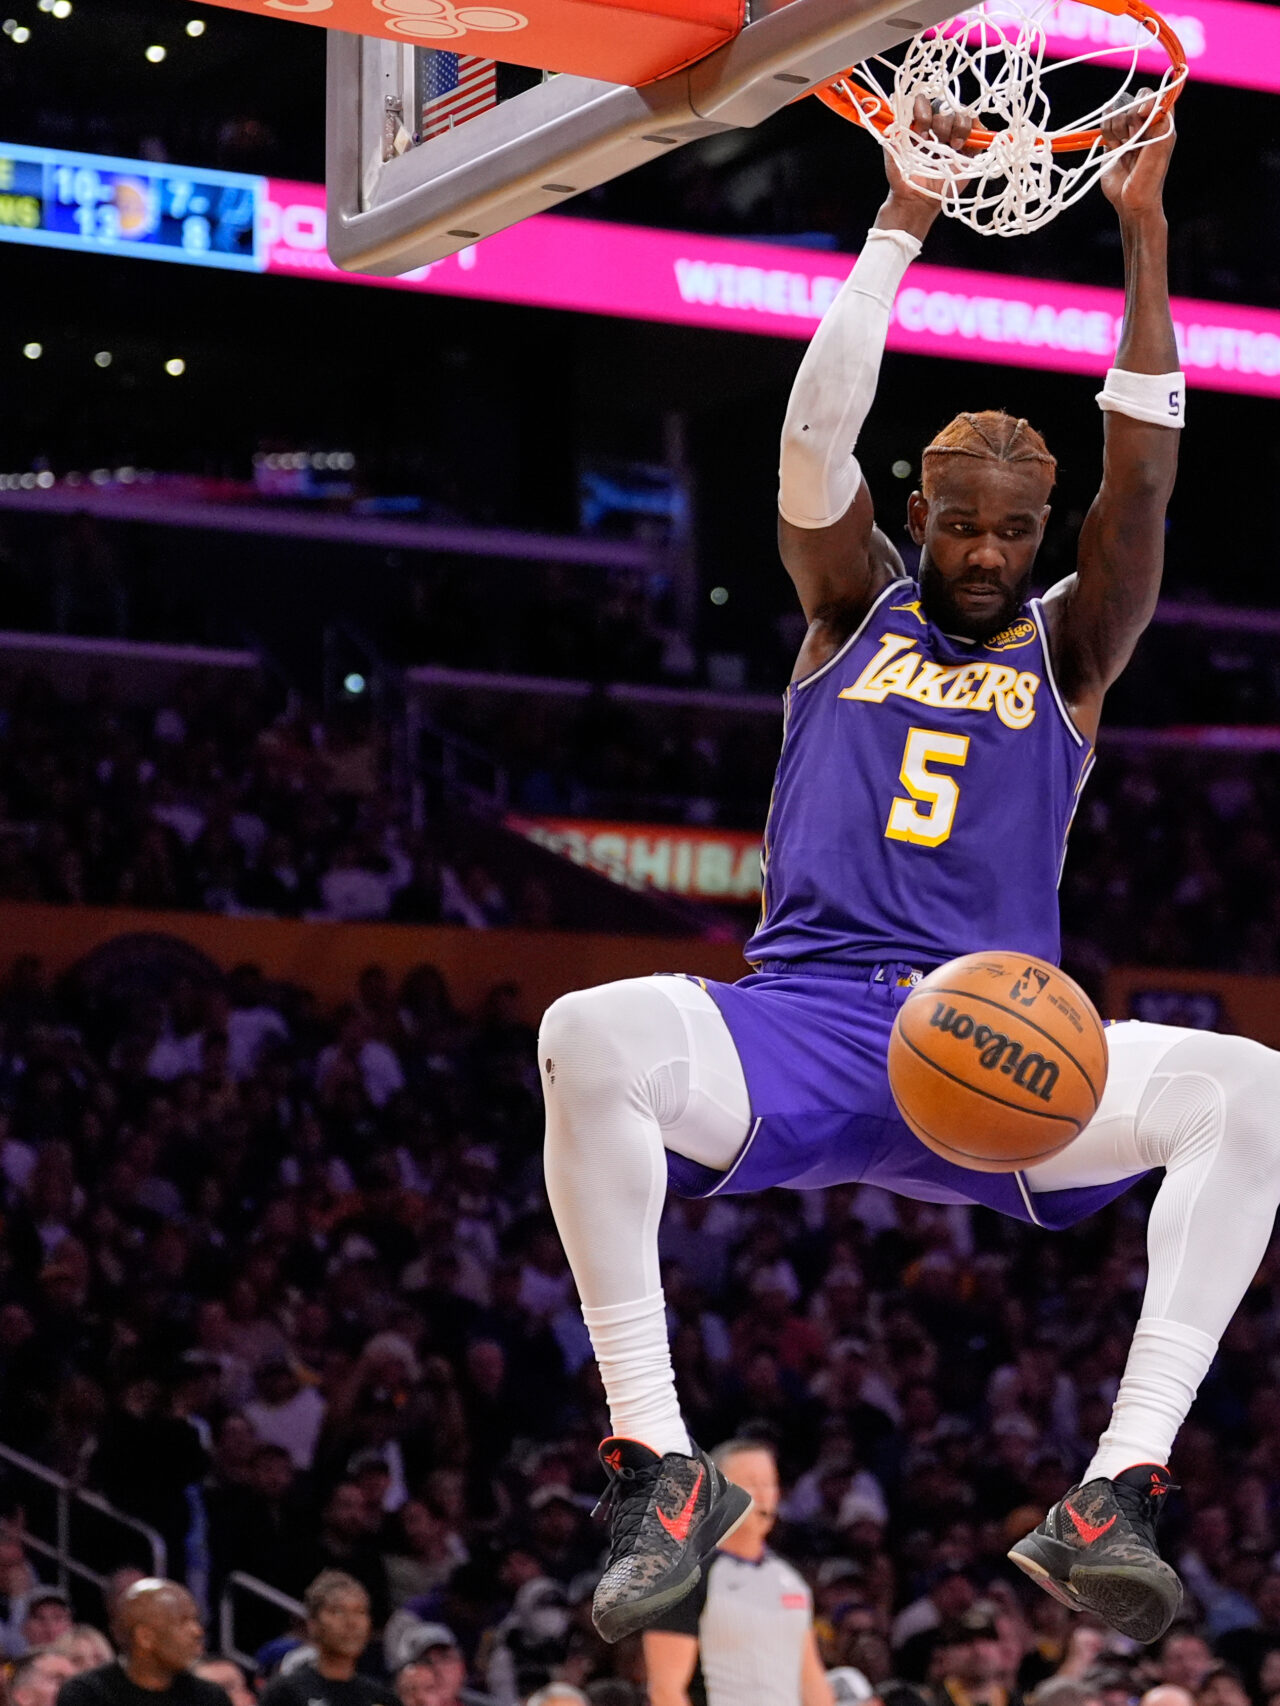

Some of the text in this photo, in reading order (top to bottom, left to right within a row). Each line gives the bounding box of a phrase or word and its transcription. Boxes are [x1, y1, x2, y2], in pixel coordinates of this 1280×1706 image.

[896, 286, 1114, 356] COVERAGE
[838, 632, 1040, 730] LAKERS
[884, 727, 970, 848] 5
[929, 1000, 1061, 1103] Wilson
